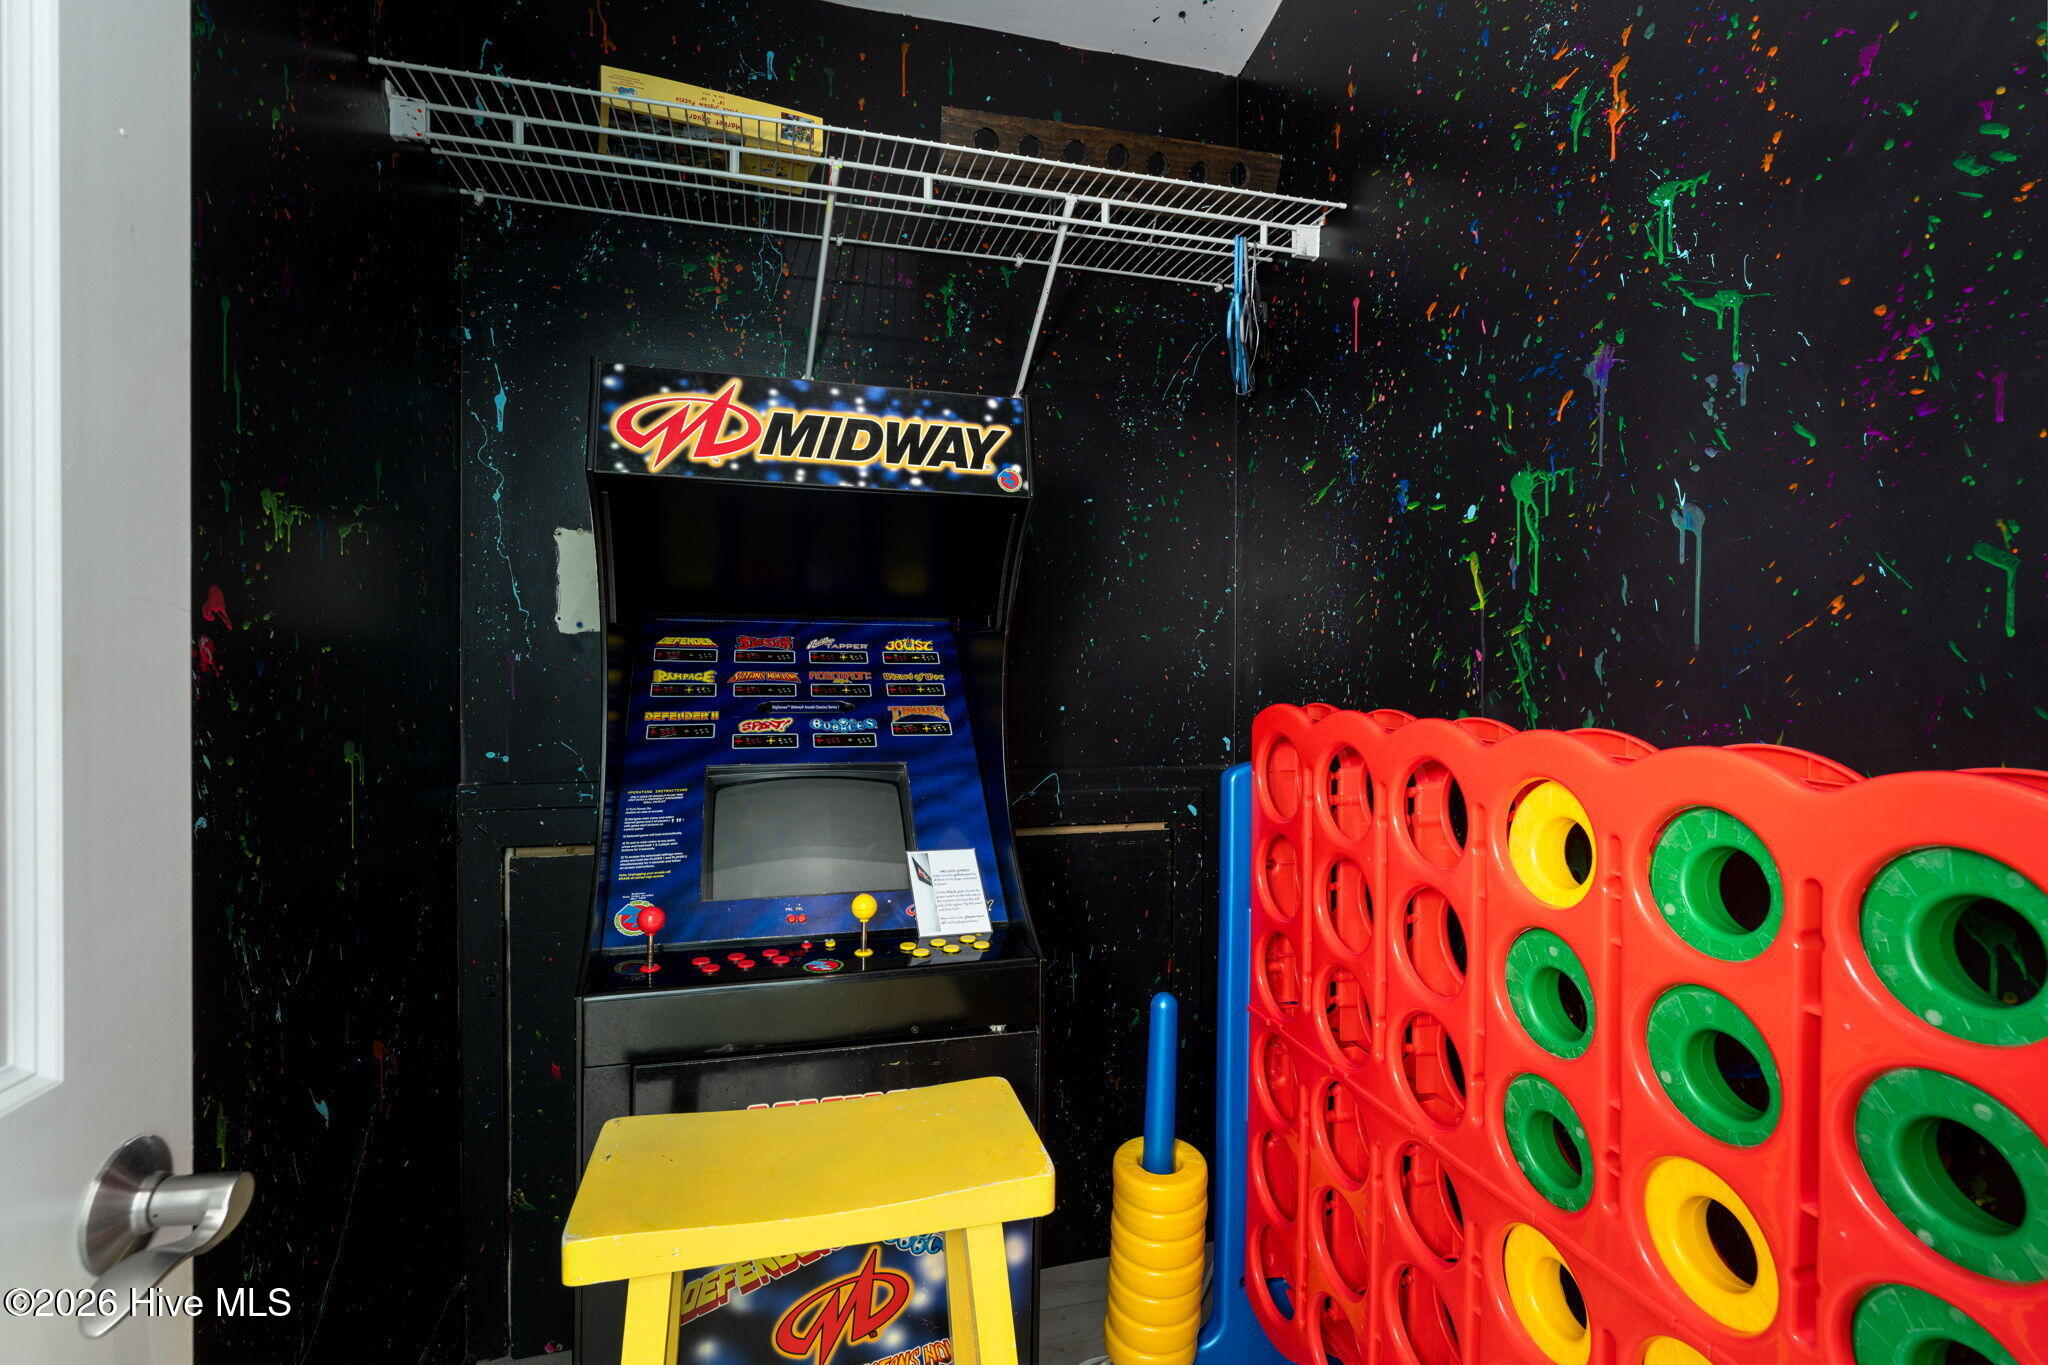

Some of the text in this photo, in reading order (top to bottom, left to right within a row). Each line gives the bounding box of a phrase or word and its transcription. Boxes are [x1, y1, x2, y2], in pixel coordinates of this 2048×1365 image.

[675, 96, 696, 106] Puzzle
[687, 113, 711, 124] Squar
[716, 119, 742, 130] Market
[757, 411, 1010, 472] MIDWAY
[656, 636, 718, 647] DEFENDER
[885, 638, 934, 651] JOUST
[653, 669, 717, 682] RAMPAGE
[914, 672, 925, 682] of
[644, 711, 709, 721] DEFENDER
[810, 718, 877, 732] BUBBLES
